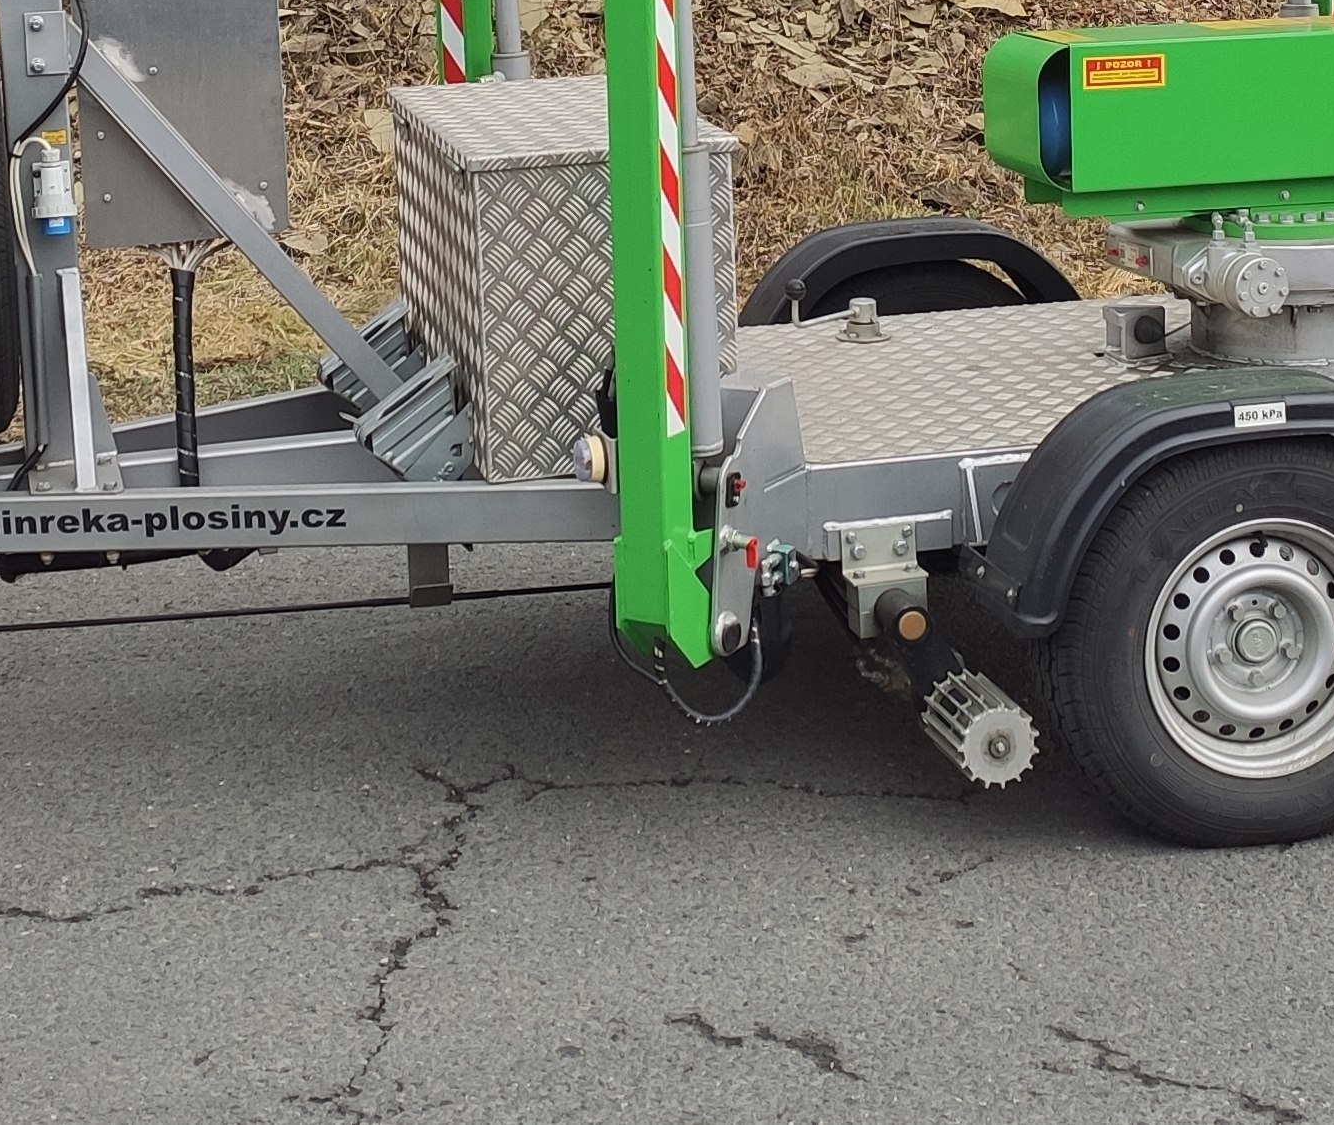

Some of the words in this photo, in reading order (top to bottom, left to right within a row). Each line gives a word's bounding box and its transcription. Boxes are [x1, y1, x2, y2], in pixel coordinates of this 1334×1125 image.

[1104, 59, 1143, 69] POZOR
[1237, 410, 1259, 422] 450
[1261, 408, 1283, 420] kPa
